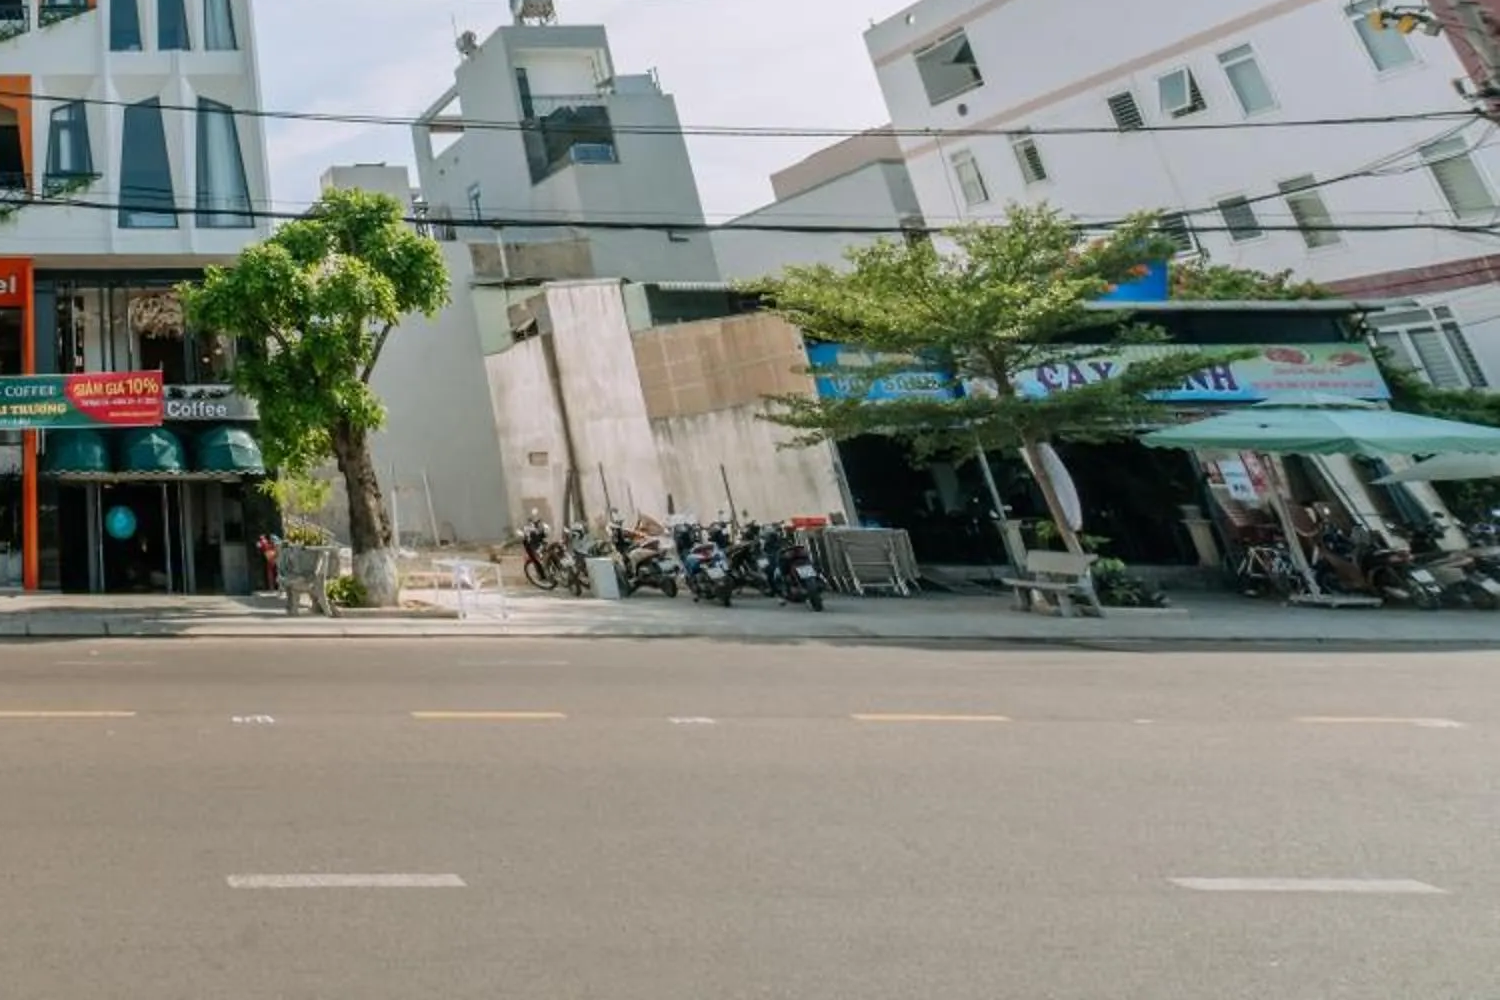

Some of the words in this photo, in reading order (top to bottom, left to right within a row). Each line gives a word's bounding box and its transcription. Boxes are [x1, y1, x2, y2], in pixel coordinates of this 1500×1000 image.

[4, 385, 57, 397] COFFEE
[126, 377, 159, 394] 10%
[167, 401, 227, 417] Coffee
